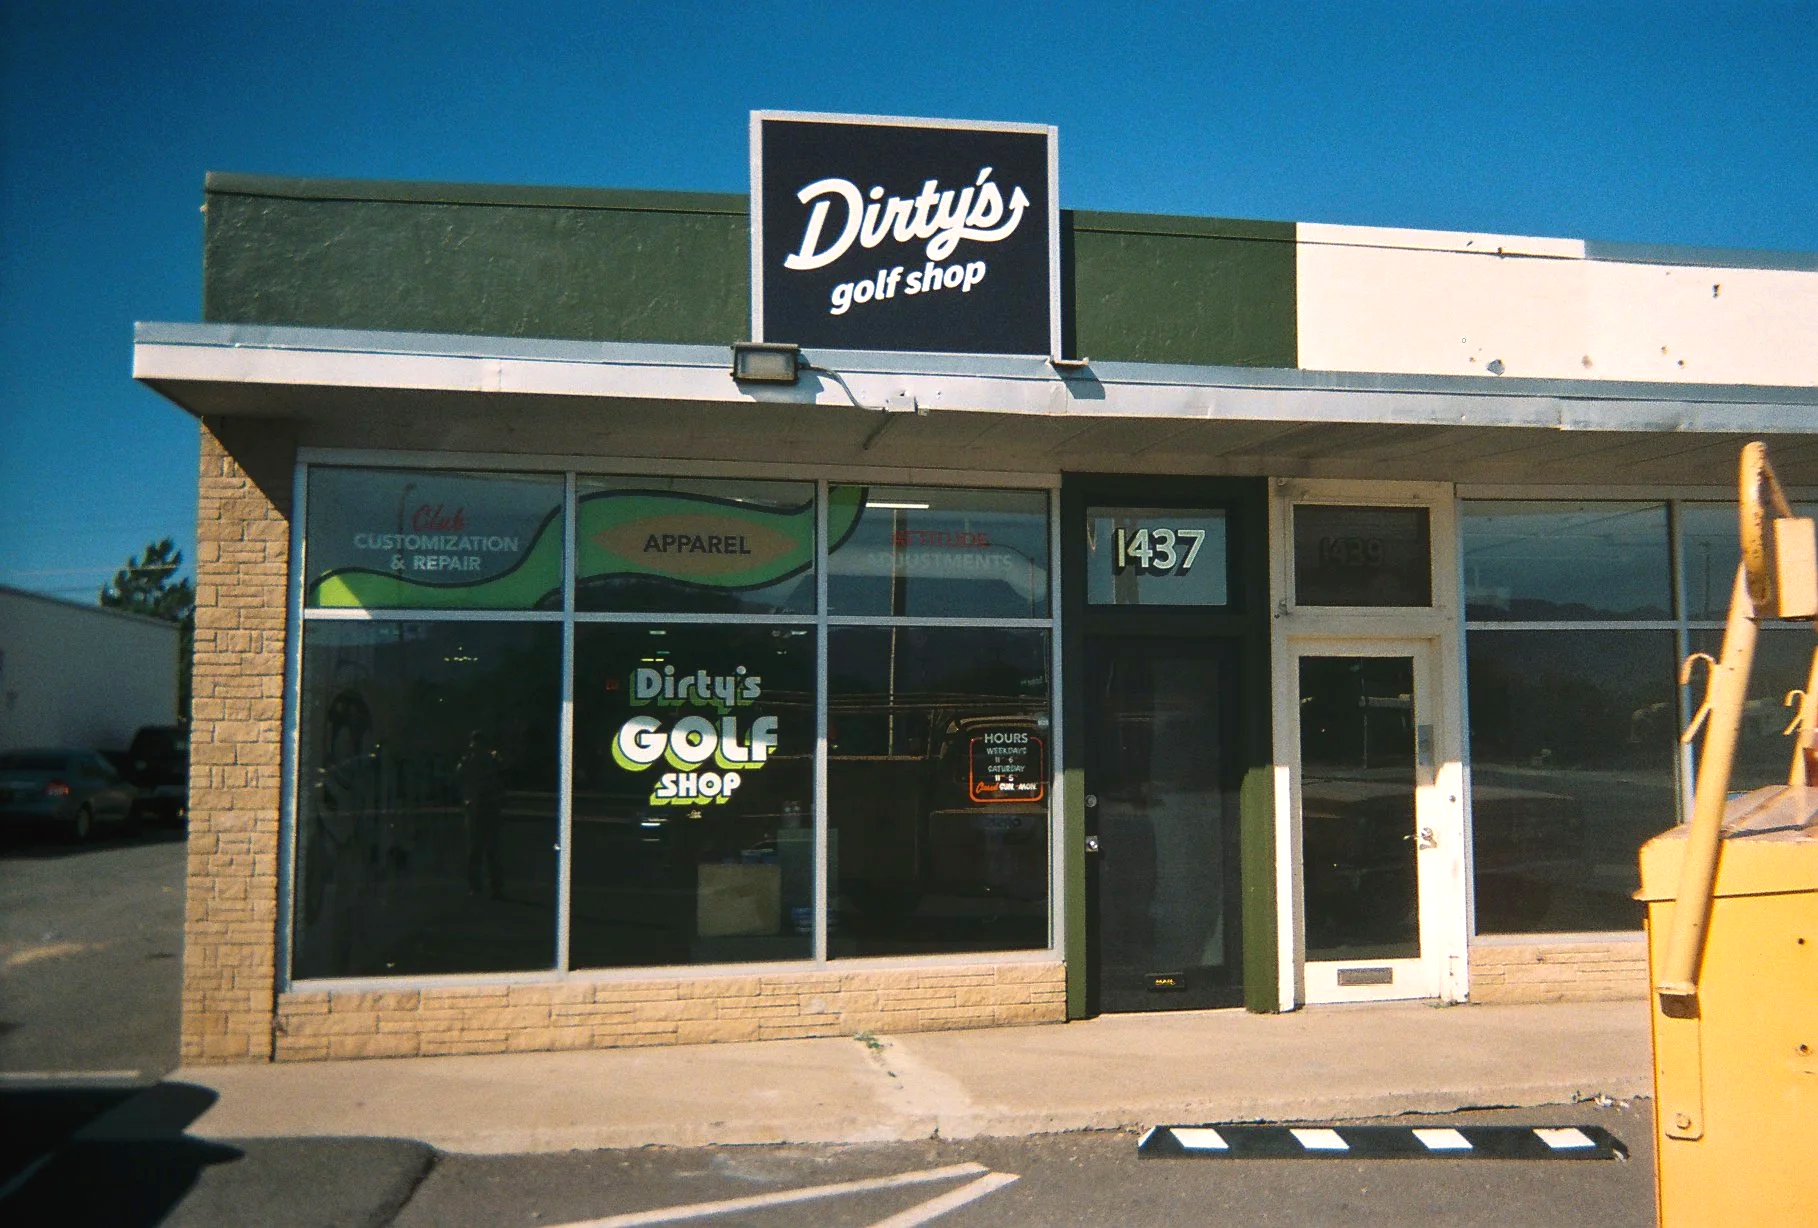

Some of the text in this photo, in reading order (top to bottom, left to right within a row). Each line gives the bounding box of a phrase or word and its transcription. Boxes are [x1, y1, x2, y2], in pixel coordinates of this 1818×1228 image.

[784, 167, 1029, 270] Dirty's
[830, 261, 986, 315] golf shop
[412, 503, 464, 532] Club
[354, 533, 519, 552] CUSTOMIZATION
[643, 533, 752, 554] APPAREL
[1116, 528, 1206, 569] 1437
[391, 554, 482, 571] & REPAIR
[635, 665, 762, 706] Dirty's
[616, 715, 779, 764] GOLF
[984, 733, 1028, 744] HOURS
[655, 772, 741, 799] SHOP
